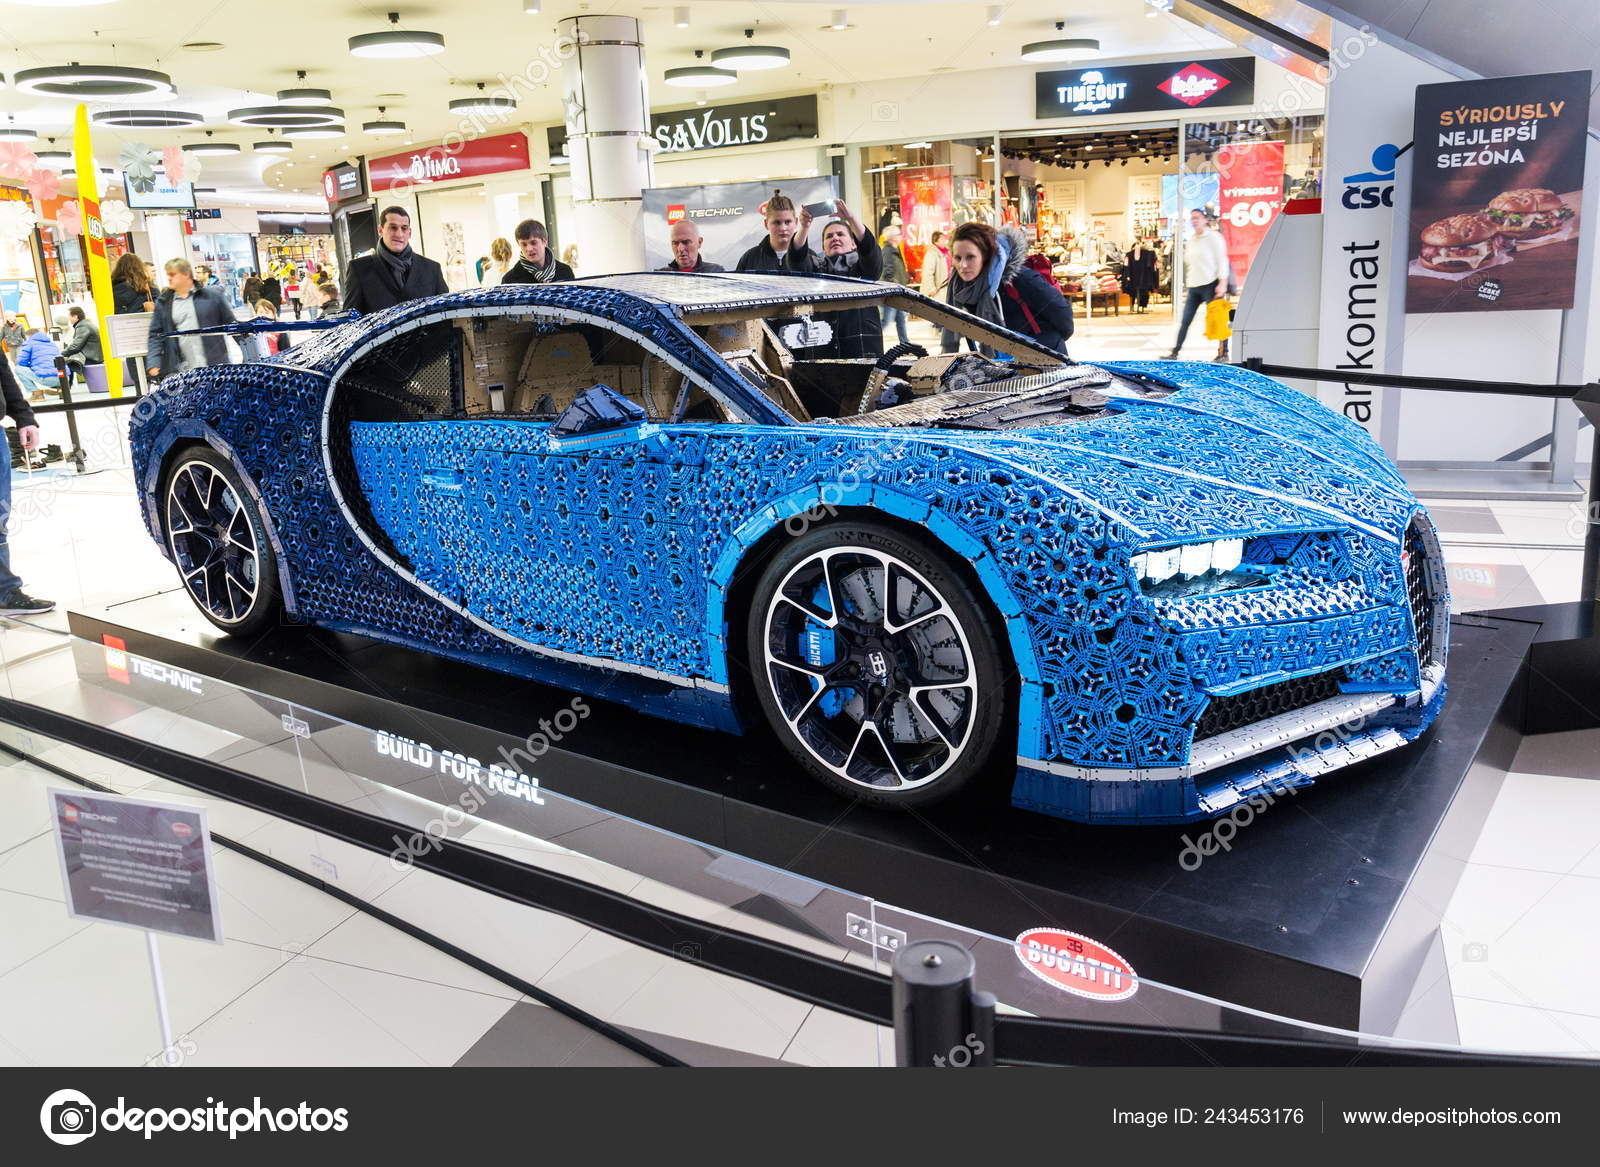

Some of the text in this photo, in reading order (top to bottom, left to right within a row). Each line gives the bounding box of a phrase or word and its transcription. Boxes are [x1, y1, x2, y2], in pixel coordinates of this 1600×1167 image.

[1057, 83, 1128, 104] TIMEOUT
[1439, 100, 1566, 127] SÝRIOUSLY
[1438, 120, 1538, 148] NEJLEPŠÍ
[1436, 145, 1526, 169] SEZÓNA
[689, 206, 744, 218] TECHNIC
[130, 657, 203, 694] TECHNIC
[376, 730, 545, 806] BUILD FOR REAL
[1027, 939, 1123, 990] BUGATTI
